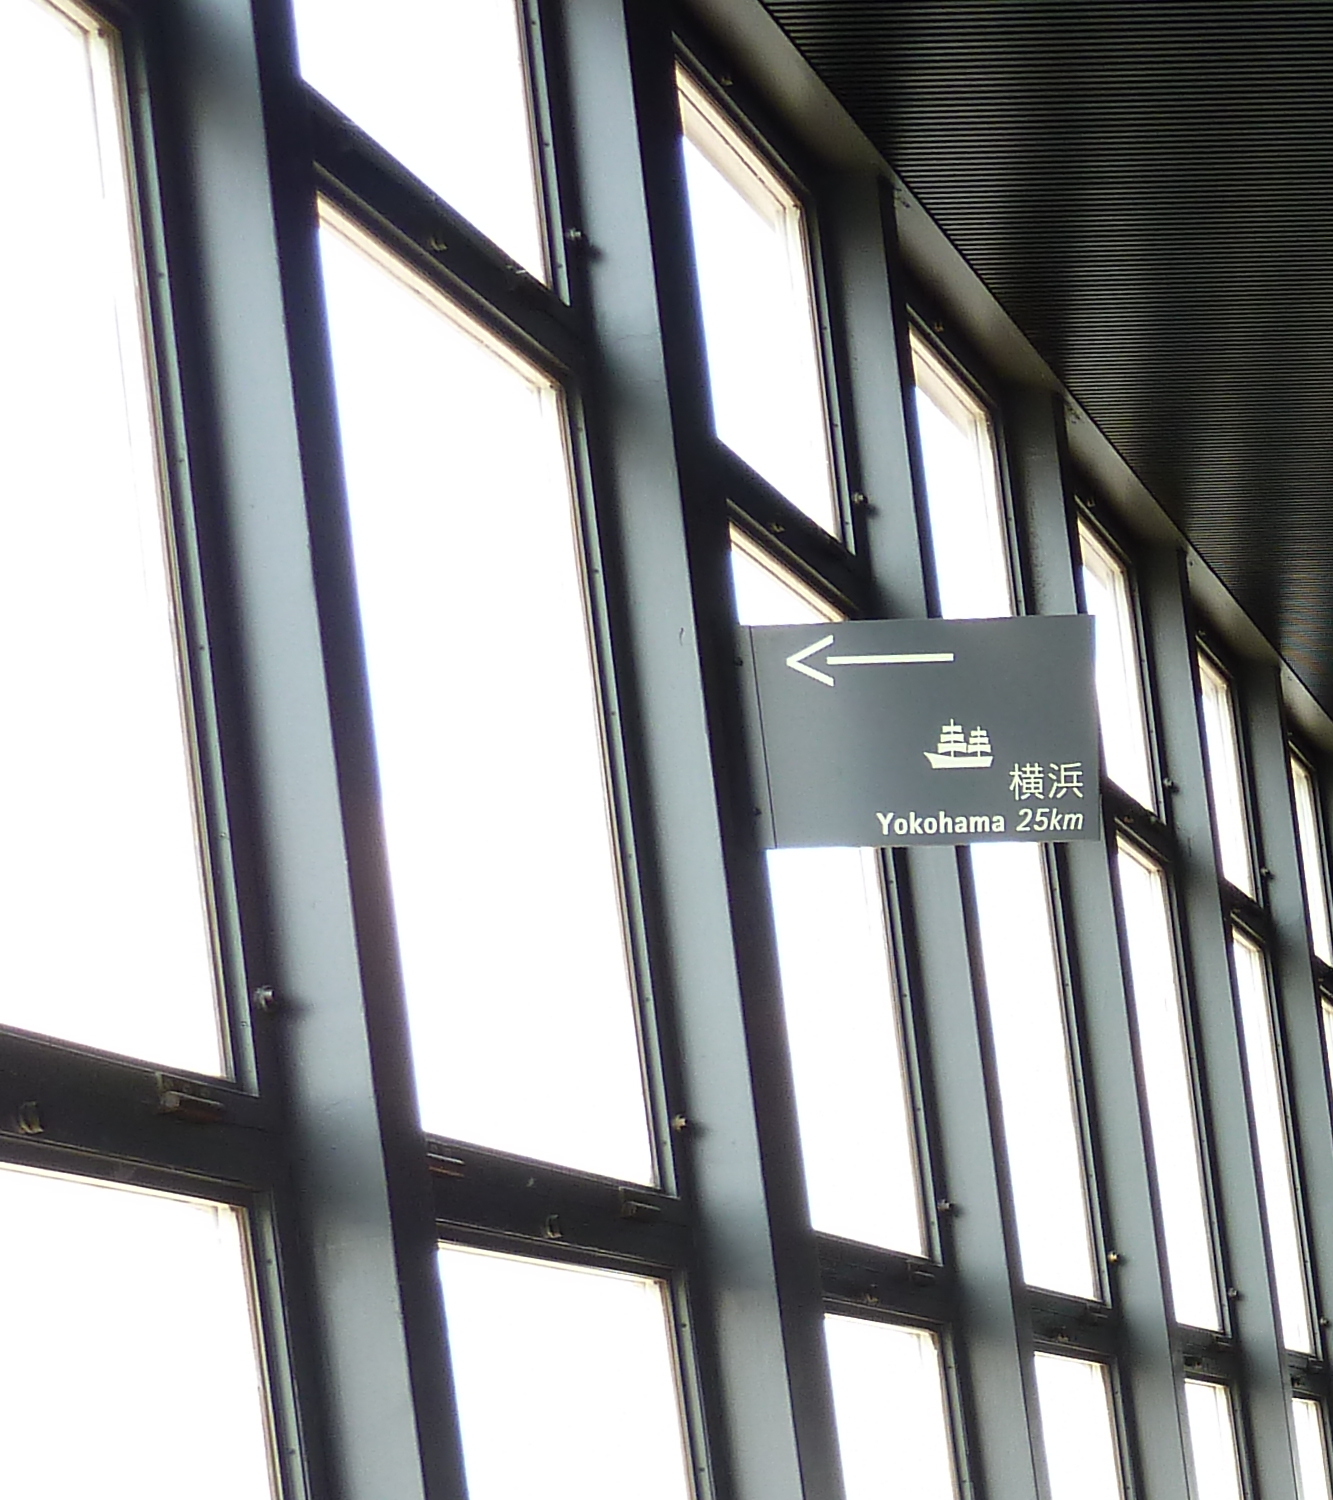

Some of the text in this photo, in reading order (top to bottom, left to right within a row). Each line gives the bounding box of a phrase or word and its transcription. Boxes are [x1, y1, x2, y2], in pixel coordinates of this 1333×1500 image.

[1009, 762, 1084, 801] 横浜
[876, 808, 1084, 835] Yokohama 25km
